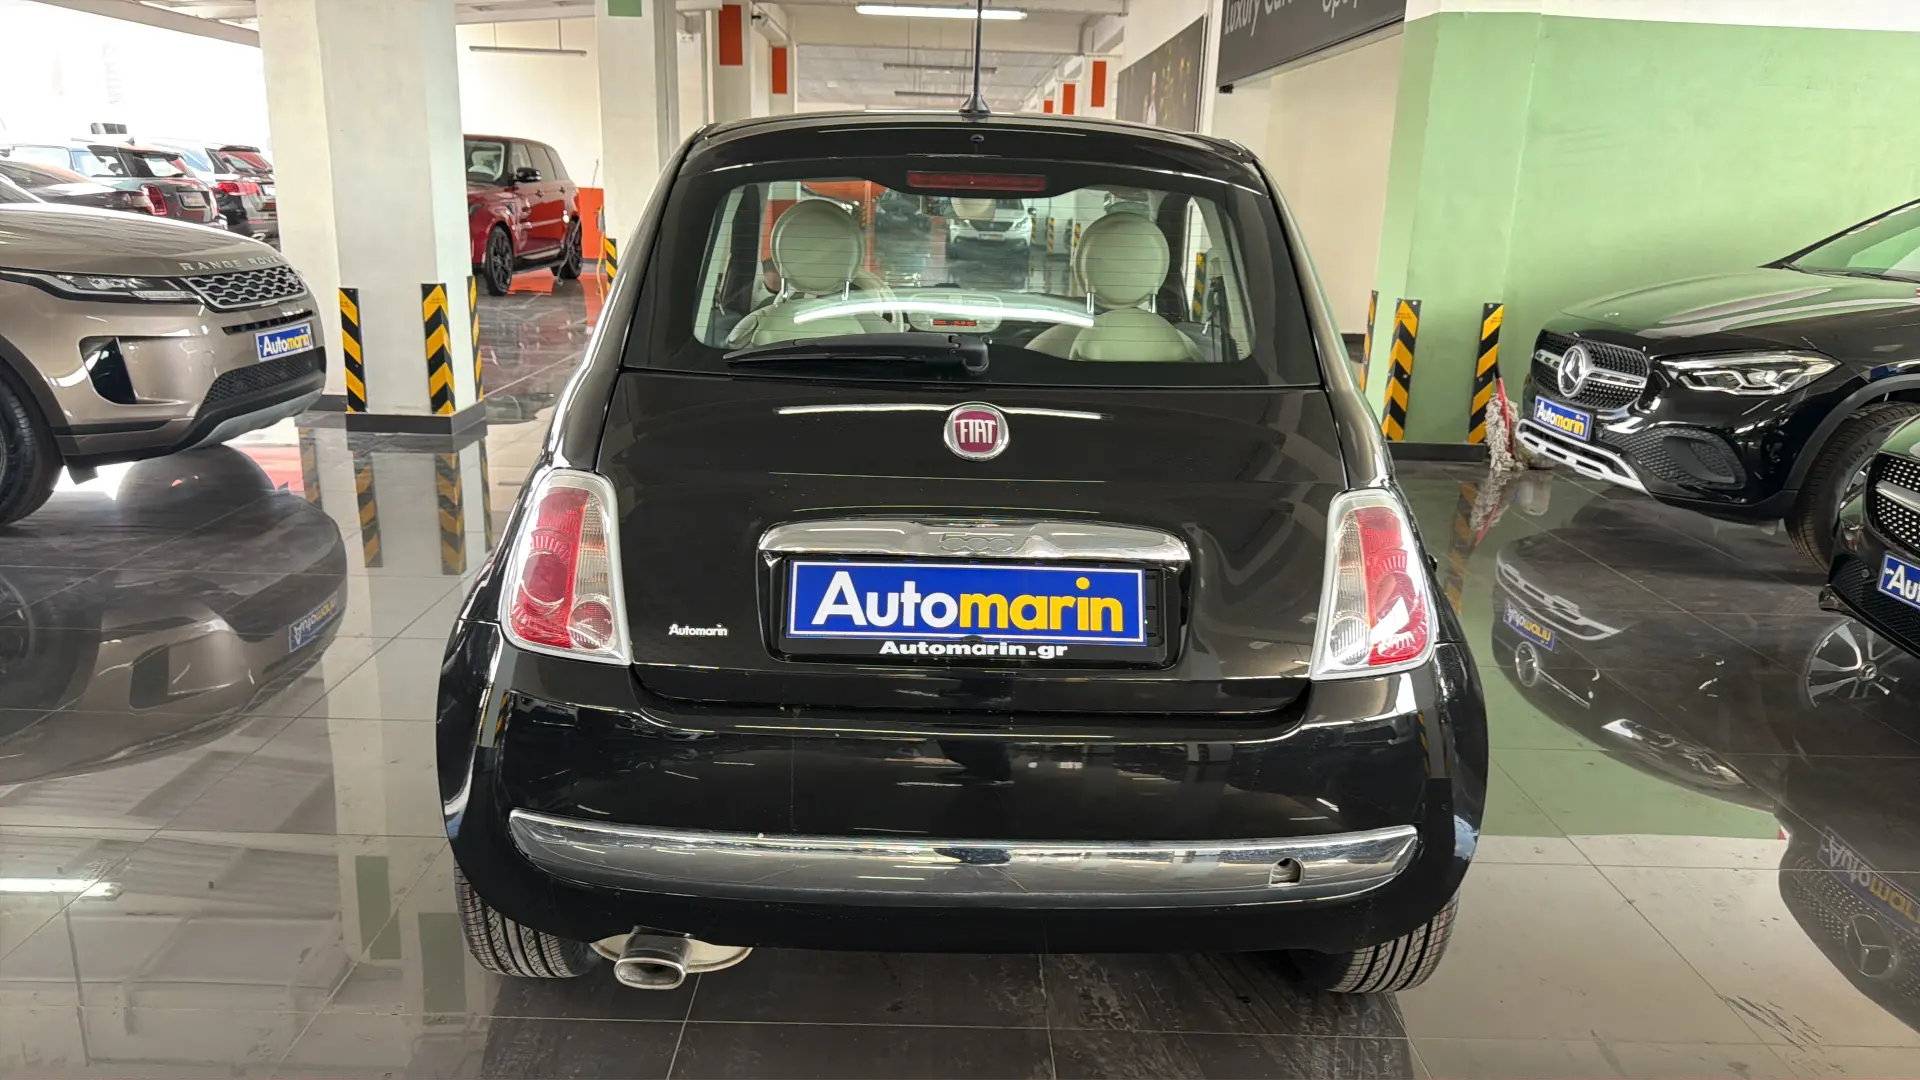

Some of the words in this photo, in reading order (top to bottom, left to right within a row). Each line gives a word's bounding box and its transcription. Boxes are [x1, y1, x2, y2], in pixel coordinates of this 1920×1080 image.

[179, 259, 243, 270] RANGE
[262, 327, 310, 356] Automarin
[954, 418, 997, 444] FIAT
[1537, 401, 1585, 435] Automarin
[810, 569, 1124, 632] Automarin
[668, 622, 728, 636] Automarin
[879, 640, 1068, 659] Automarin.gr
